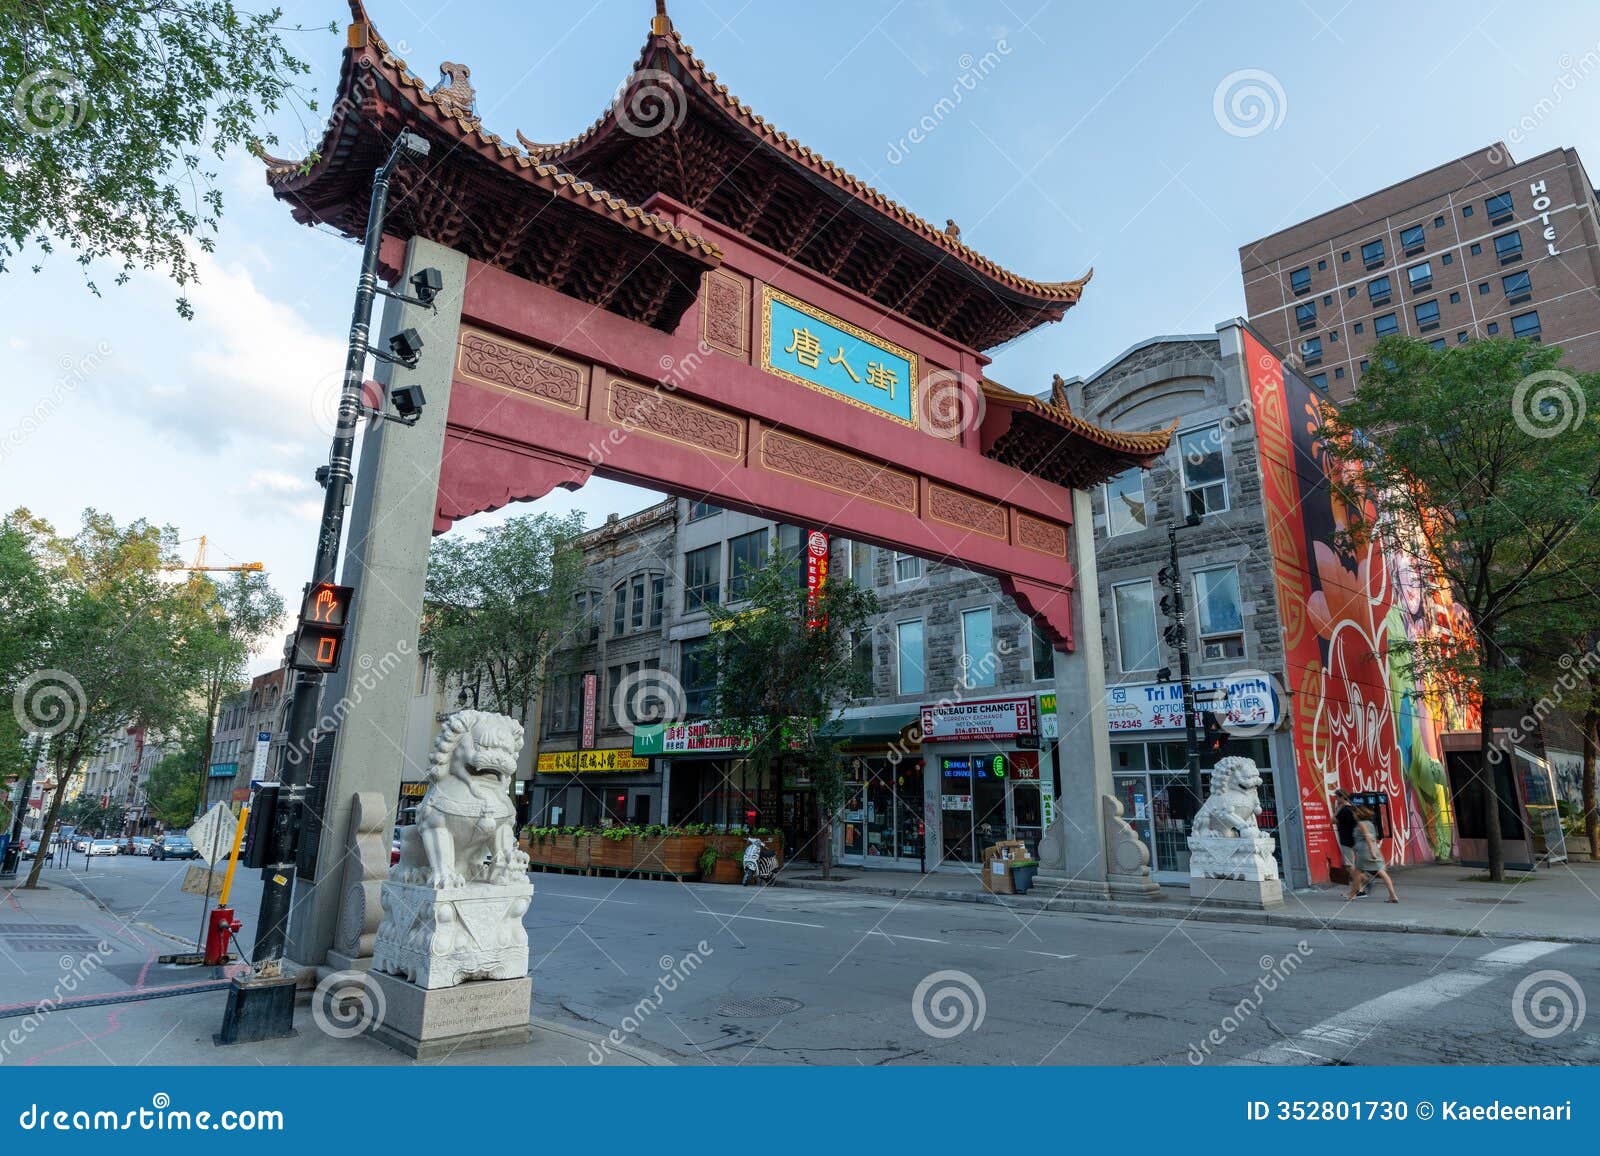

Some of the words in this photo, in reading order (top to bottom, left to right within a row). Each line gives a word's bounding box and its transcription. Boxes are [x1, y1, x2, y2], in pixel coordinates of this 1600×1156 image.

[1530, 179, 1560, 256] HOTEL
[784, 327, 899, 401] 唐人街
[316, 637, 337, 663] 0
[1145, 686, 1164, 701] Tri
[933, 706, 965, 716] BUREAU
[967, 706, 978, 714] DE
[980, 703, 1015, 713] CHANGE
[1153, 703, 1186, 714] OPTICIE
[1212, 697, 1260, 710] QUARTIER
